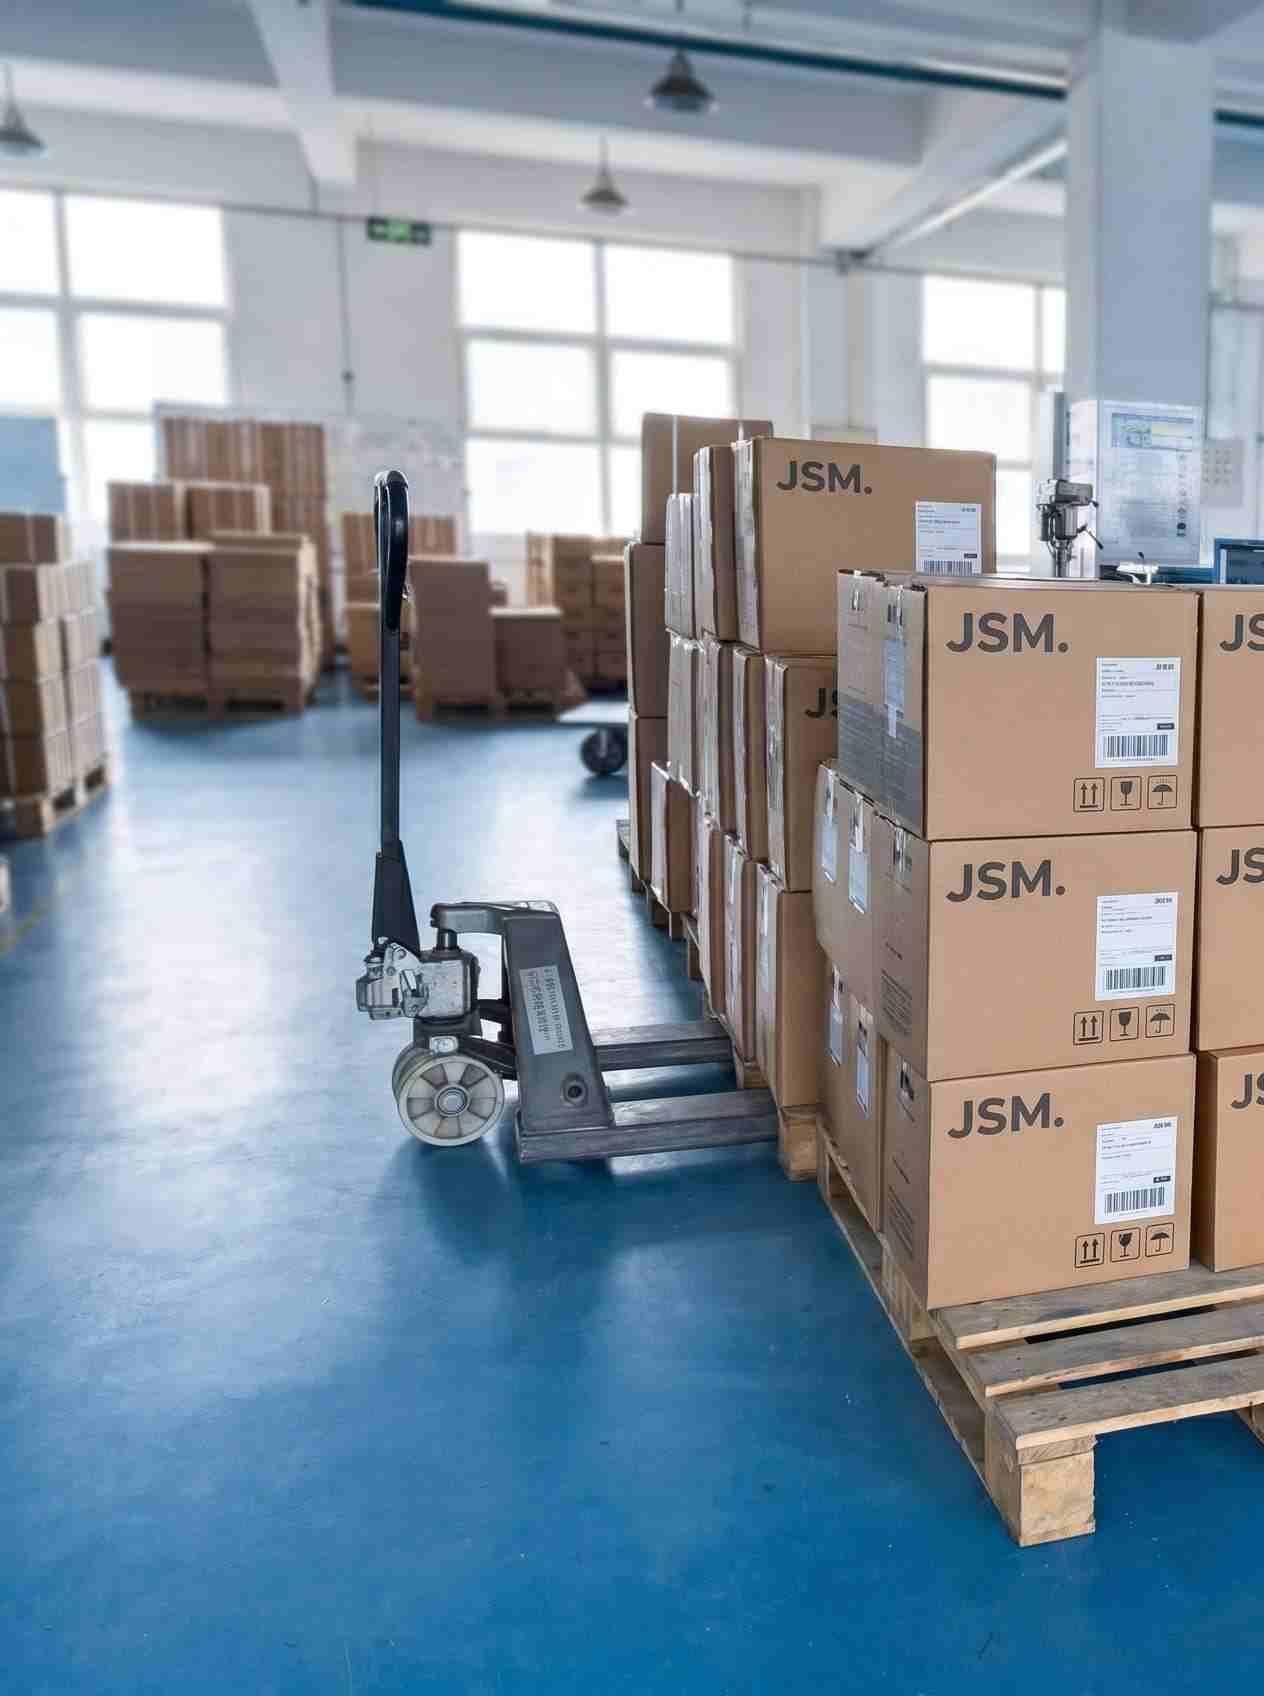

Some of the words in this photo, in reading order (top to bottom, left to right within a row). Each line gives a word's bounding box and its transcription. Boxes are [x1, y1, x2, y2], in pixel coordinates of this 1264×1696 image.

[776, 460, 873, 495] JSM.
[945, 611, 1069, 654] JSM.
[945, 859, 1067, 903] JSM.
[947, 1092, 1066, 1140] JSM.
